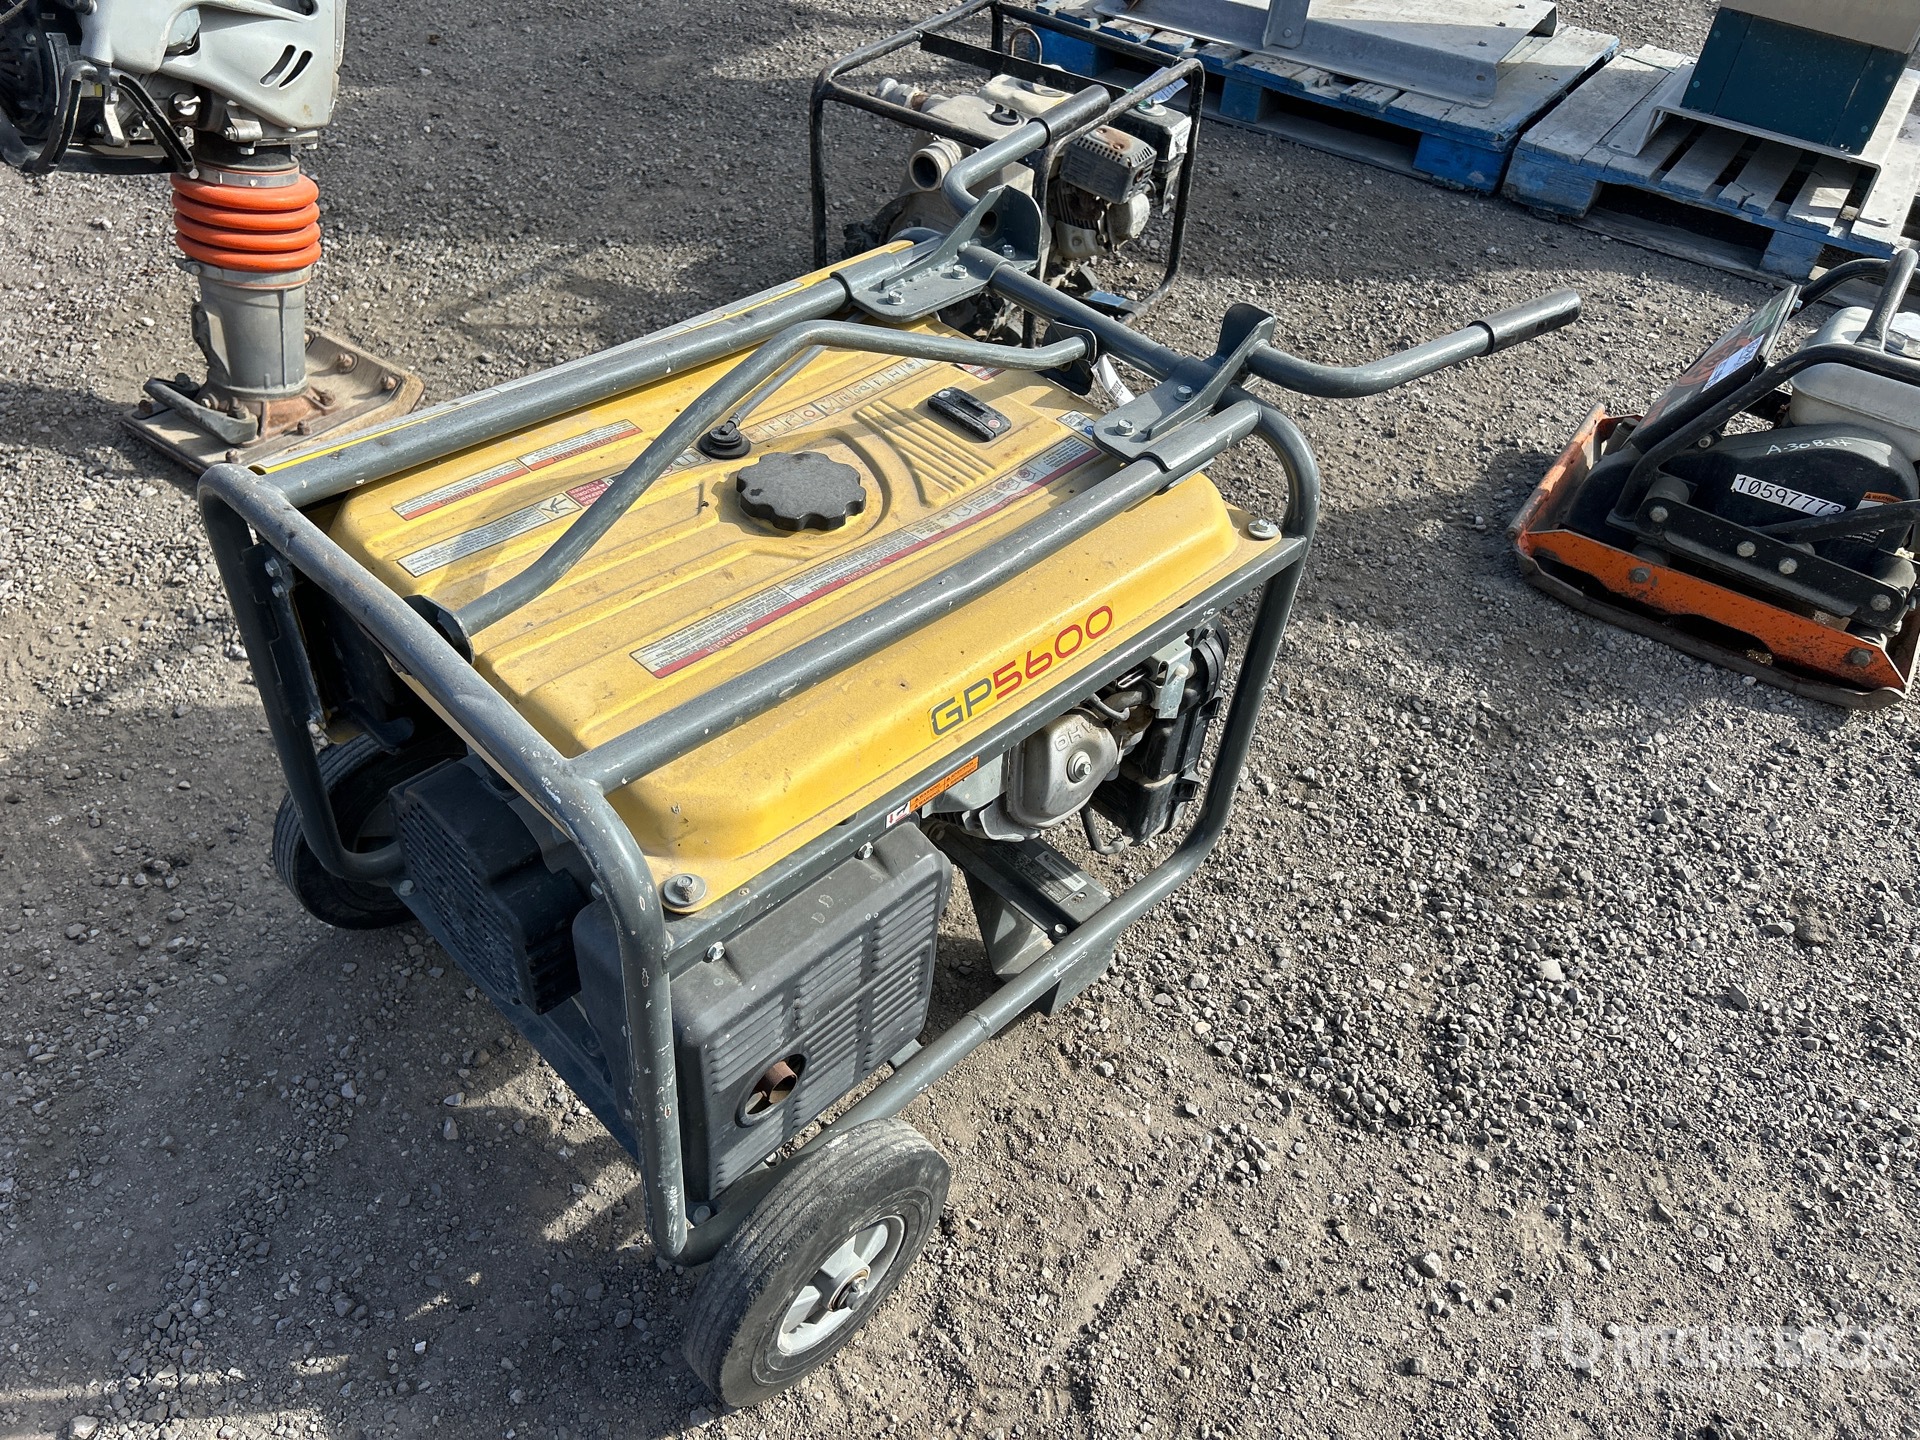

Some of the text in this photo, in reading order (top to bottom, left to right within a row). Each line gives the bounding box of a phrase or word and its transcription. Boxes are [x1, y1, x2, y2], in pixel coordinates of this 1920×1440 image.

[1766, 444, 1810, 455] A-30
[441, 486, 482, 506] WARNING
[707, 630, 743, 653] DANGER
[931, 605, 1113, 736] GP5600
